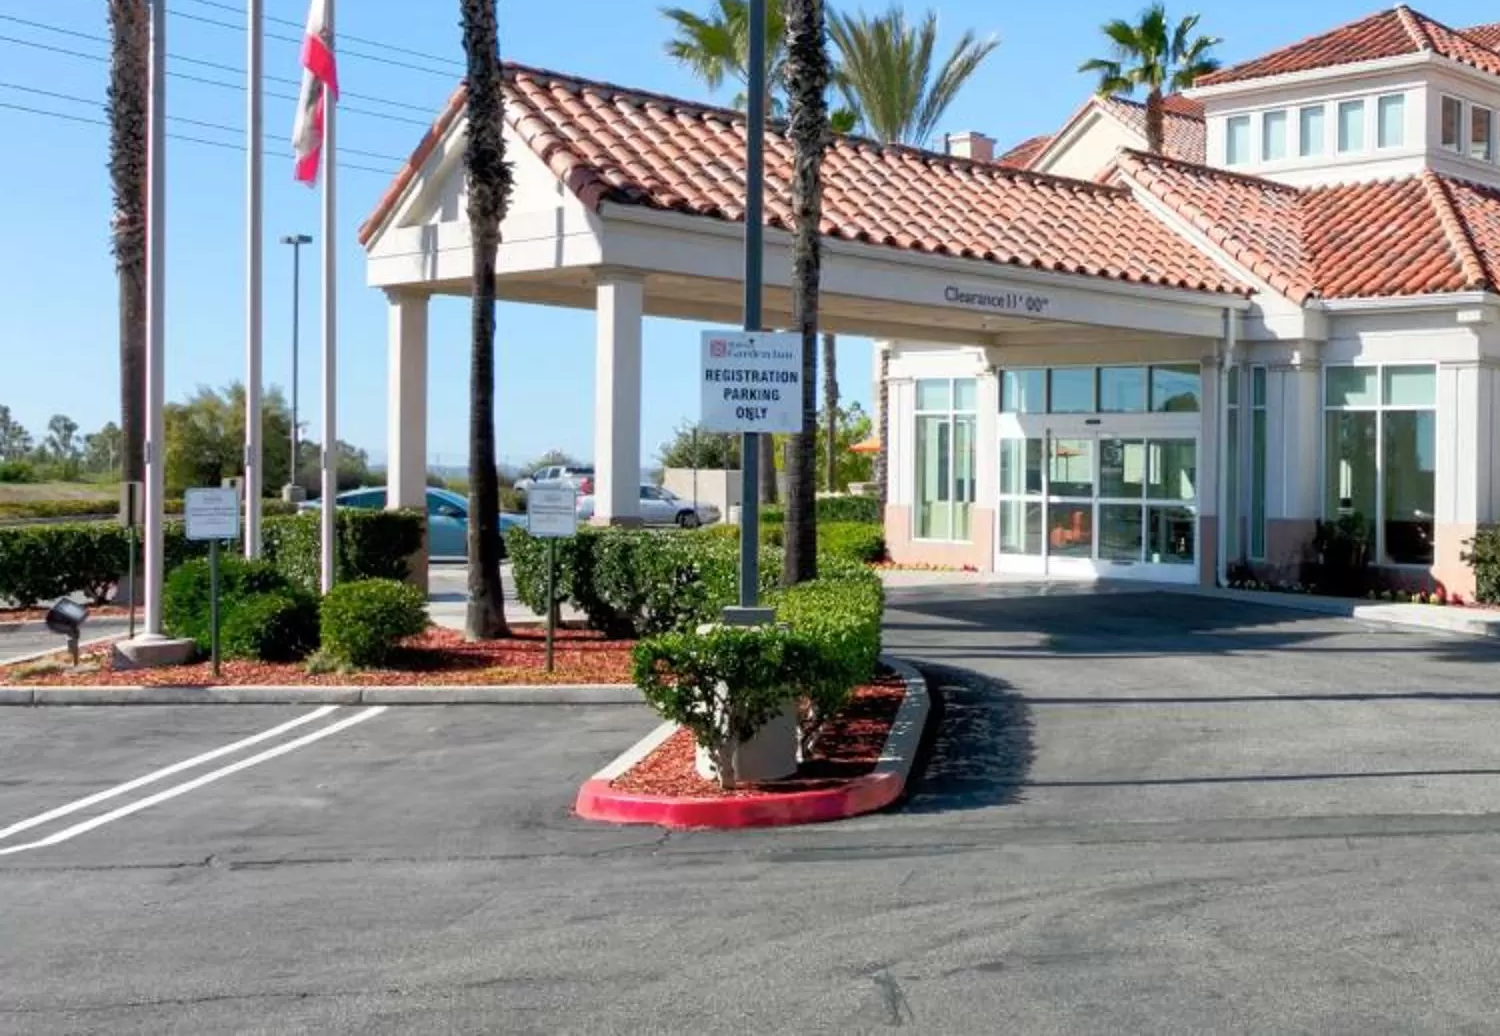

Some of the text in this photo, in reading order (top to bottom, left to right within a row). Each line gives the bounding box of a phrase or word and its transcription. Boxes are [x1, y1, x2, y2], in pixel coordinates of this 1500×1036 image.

[944, 285, 1005, 309] Clearance
[705, 369, 798, 383] REGISTRATION
[723, 388, 780, 401] PARKING
[736, 407, 768, 421] ONLY
